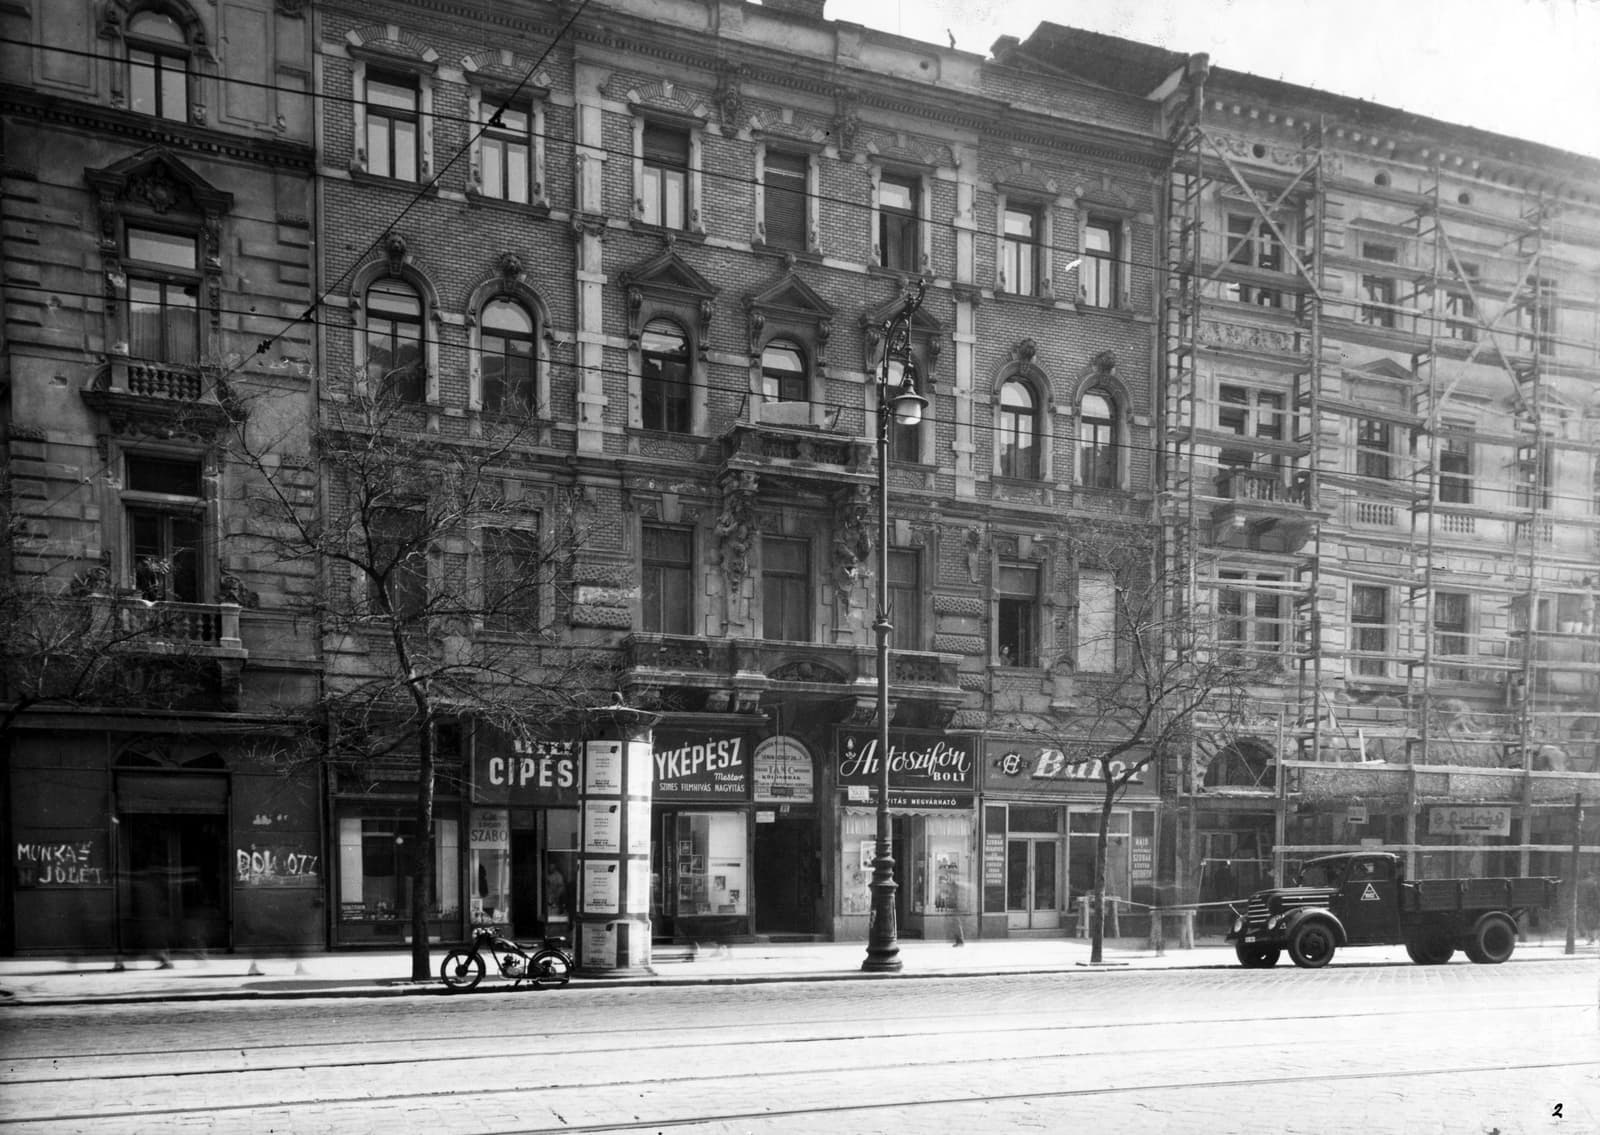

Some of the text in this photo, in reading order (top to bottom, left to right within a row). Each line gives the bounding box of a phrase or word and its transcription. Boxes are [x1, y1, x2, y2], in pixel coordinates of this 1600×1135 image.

[653, 737, 743, 781] YKÉPÉSZ
[489, 755, 581, 788] CIPÉS
[933, 772, 967, 782] BOLT
[911, 797, 957, 806] MEGVÁRHATÓ
